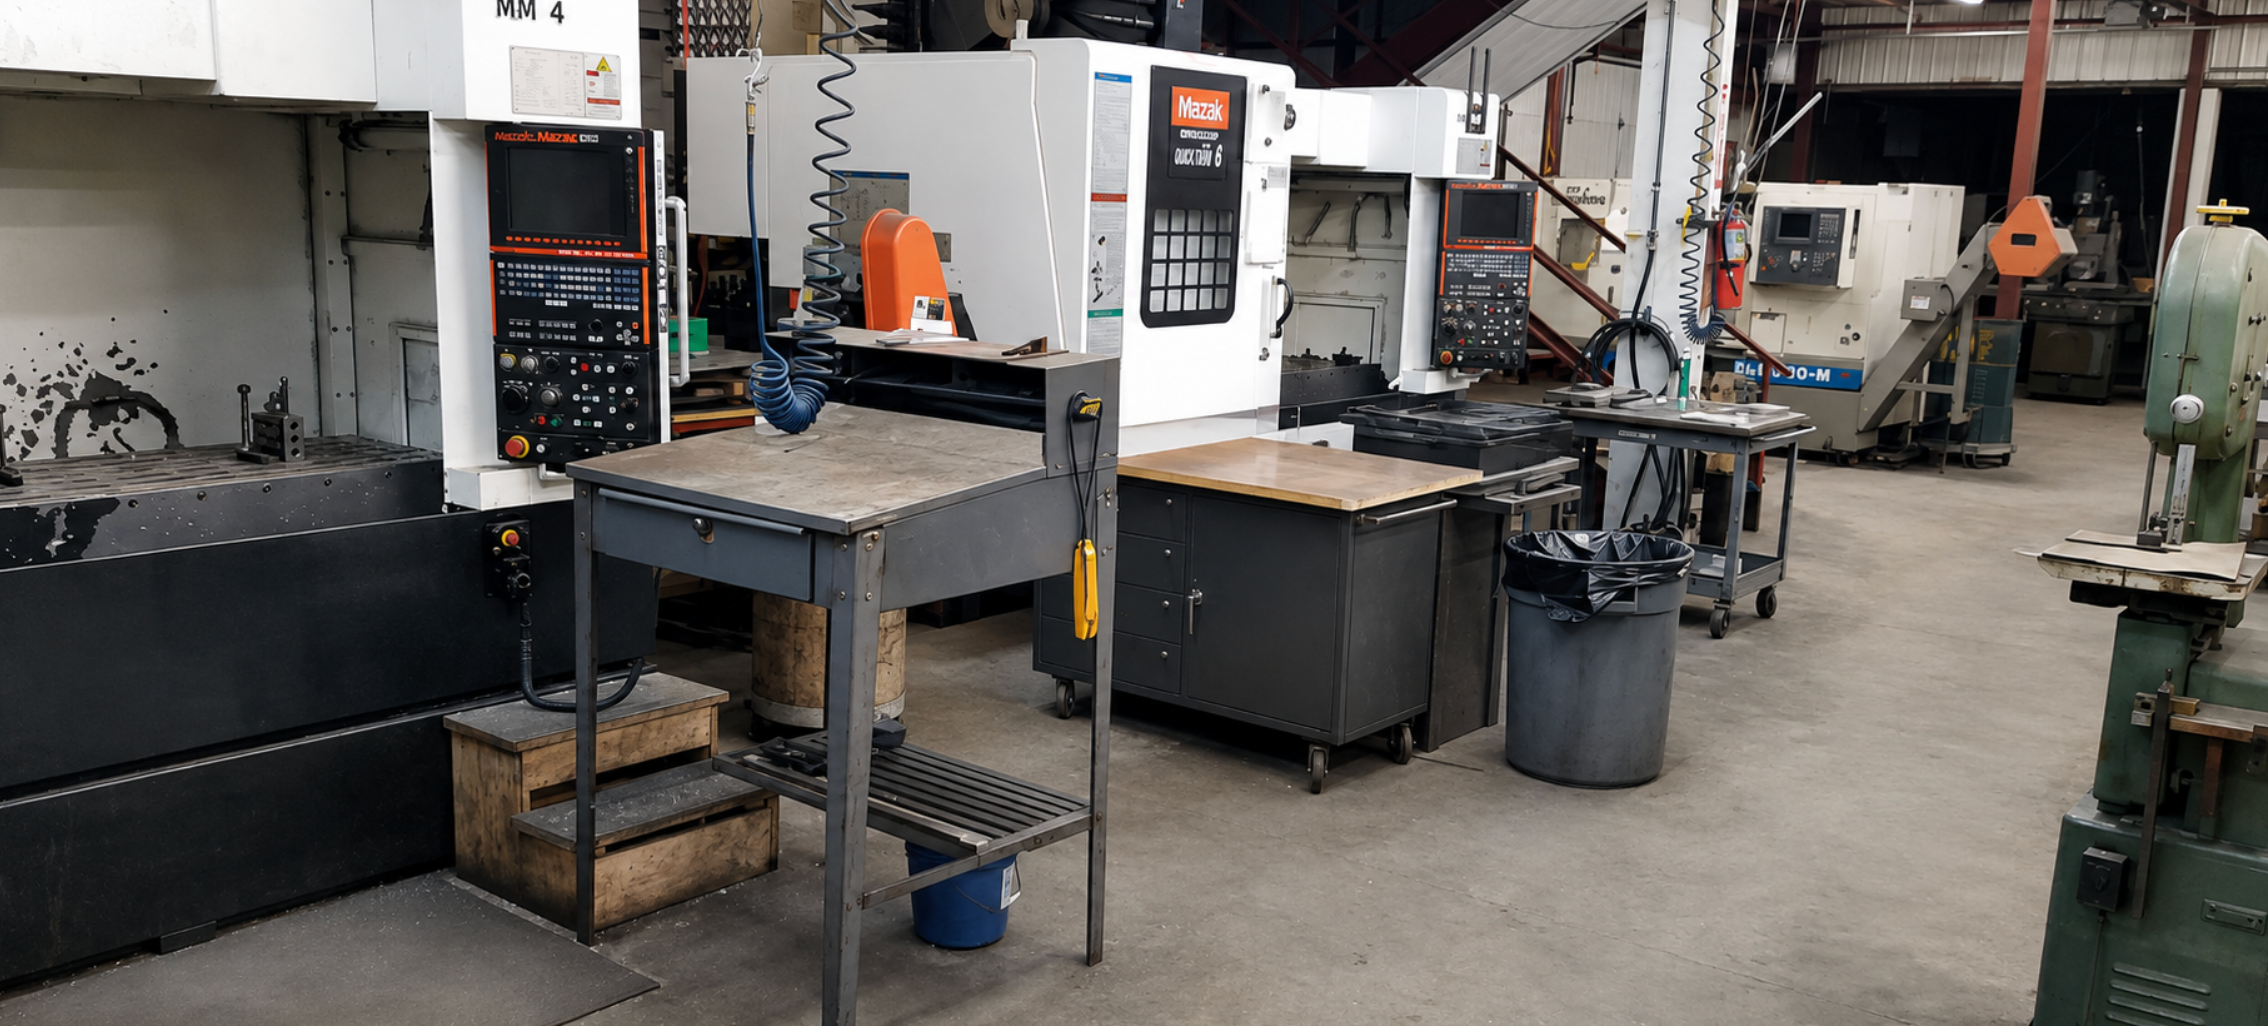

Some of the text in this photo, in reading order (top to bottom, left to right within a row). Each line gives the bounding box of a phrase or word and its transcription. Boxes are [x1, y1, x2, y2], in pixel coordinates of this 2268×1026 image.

[496, 0, 565, 24] MM 4
[1178, 94, 1224, 122] Mazak
[1214, 143, 1223, 167] 6
